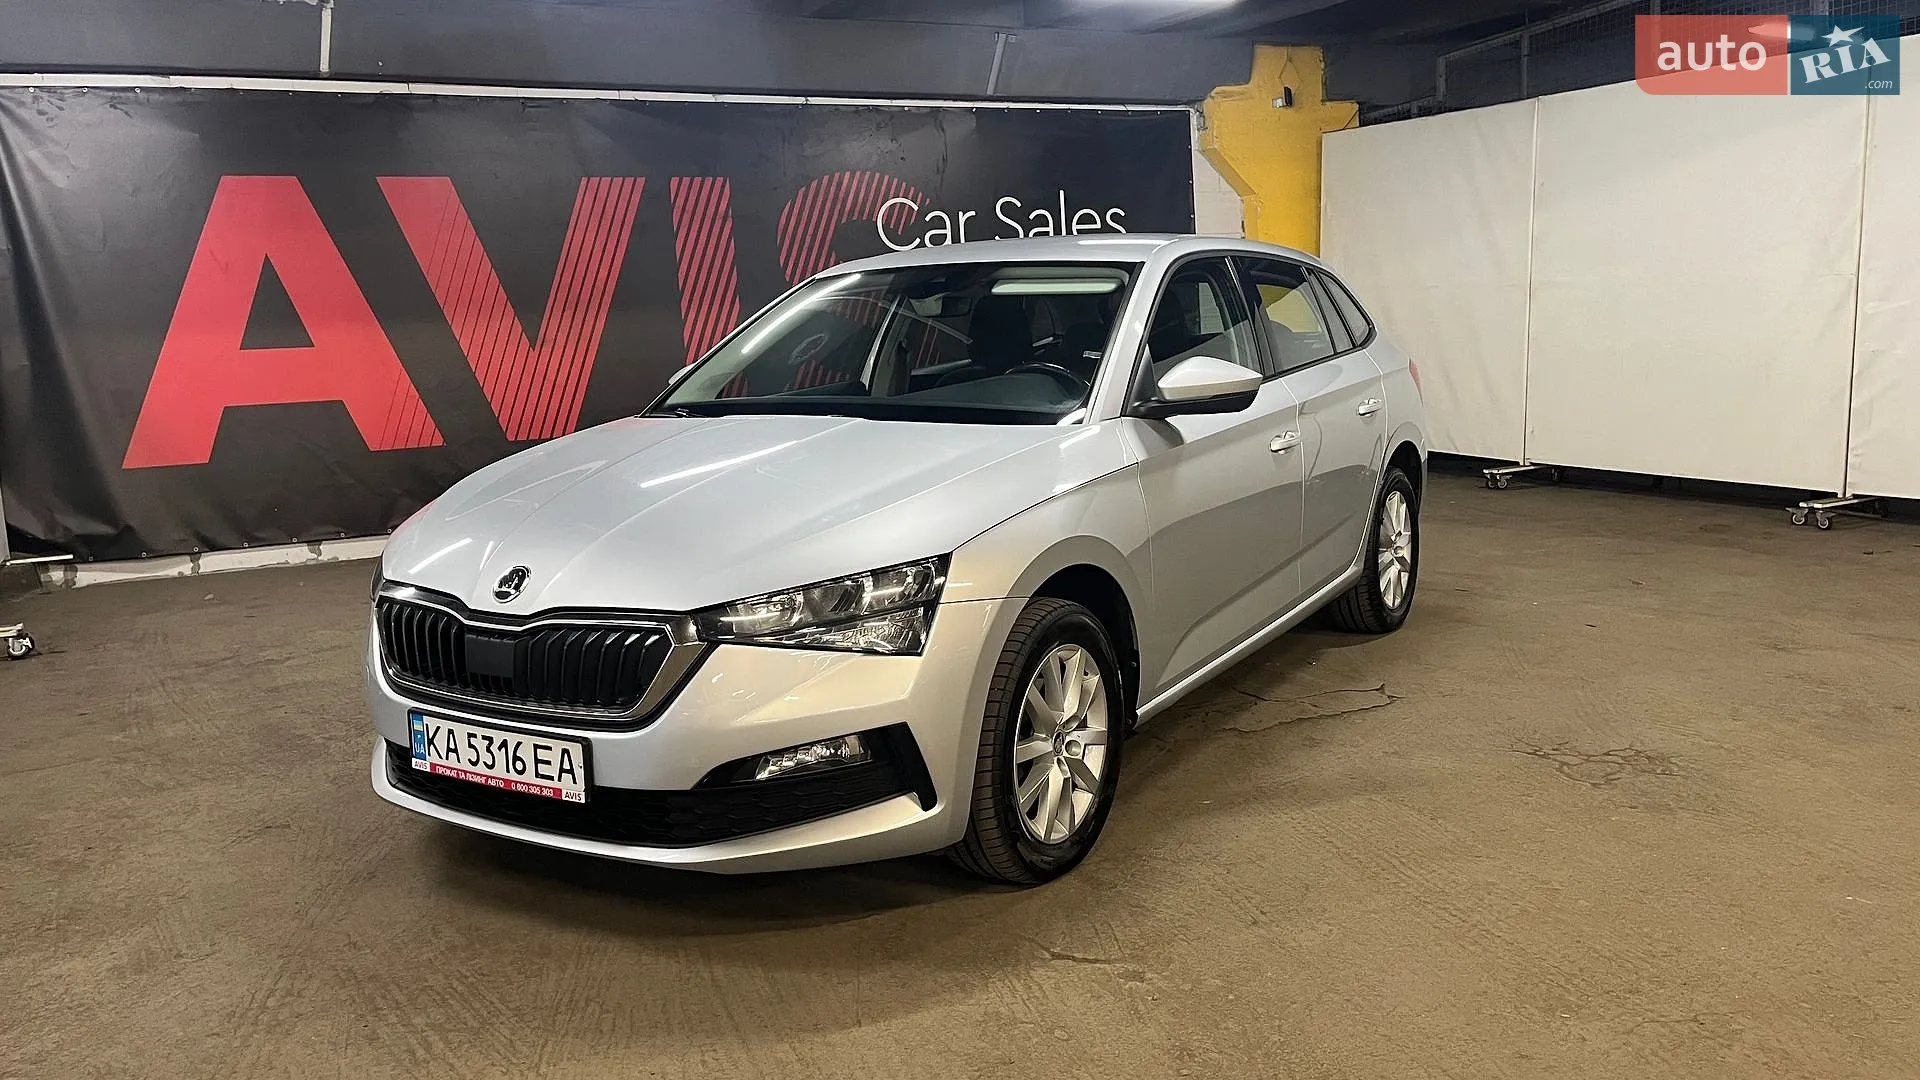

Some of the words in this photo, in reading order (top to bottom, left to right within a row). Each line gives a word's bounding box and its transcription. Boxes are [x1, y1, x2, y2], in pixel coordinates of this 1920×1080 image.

[876, 197, 976, 251] Car
[994, 189, 1127, 241] Sales
[414, 742, 426, 754] UA
[425, 722, 462, 764] KA
[466, 731, 528, 776] 5316
[532, 742, 578, 785] EA
[435, 765, 458, 779] ПРОКАТ
[487, 778, 505, 788] АВТО
[528, 785, 541, 794] 305
[541, 787, 554, 797] 303
[564, 791, 582, 801] AVIS
